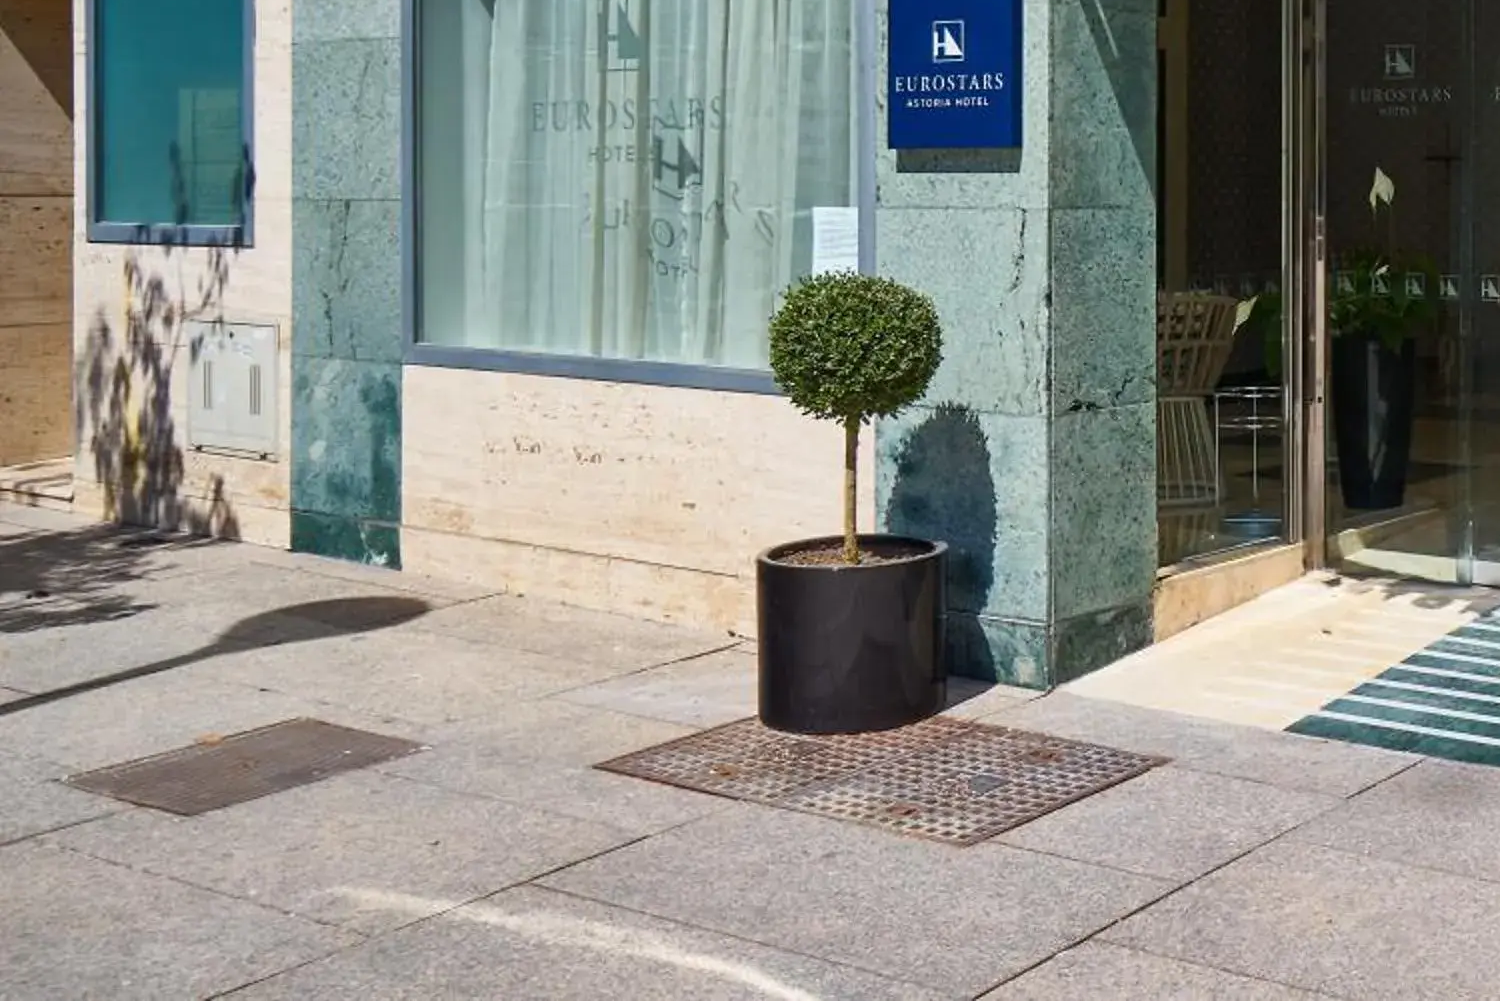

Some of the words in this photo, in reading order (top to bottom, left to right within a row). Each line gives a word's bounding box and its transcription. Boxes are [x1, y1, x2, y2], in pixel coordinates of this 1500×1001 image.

[895, 72, 1004, 92] EUROSTARS
[906, 97, 951, 108] ASTORIA
[955, 96, 989, 107] HOTEL
